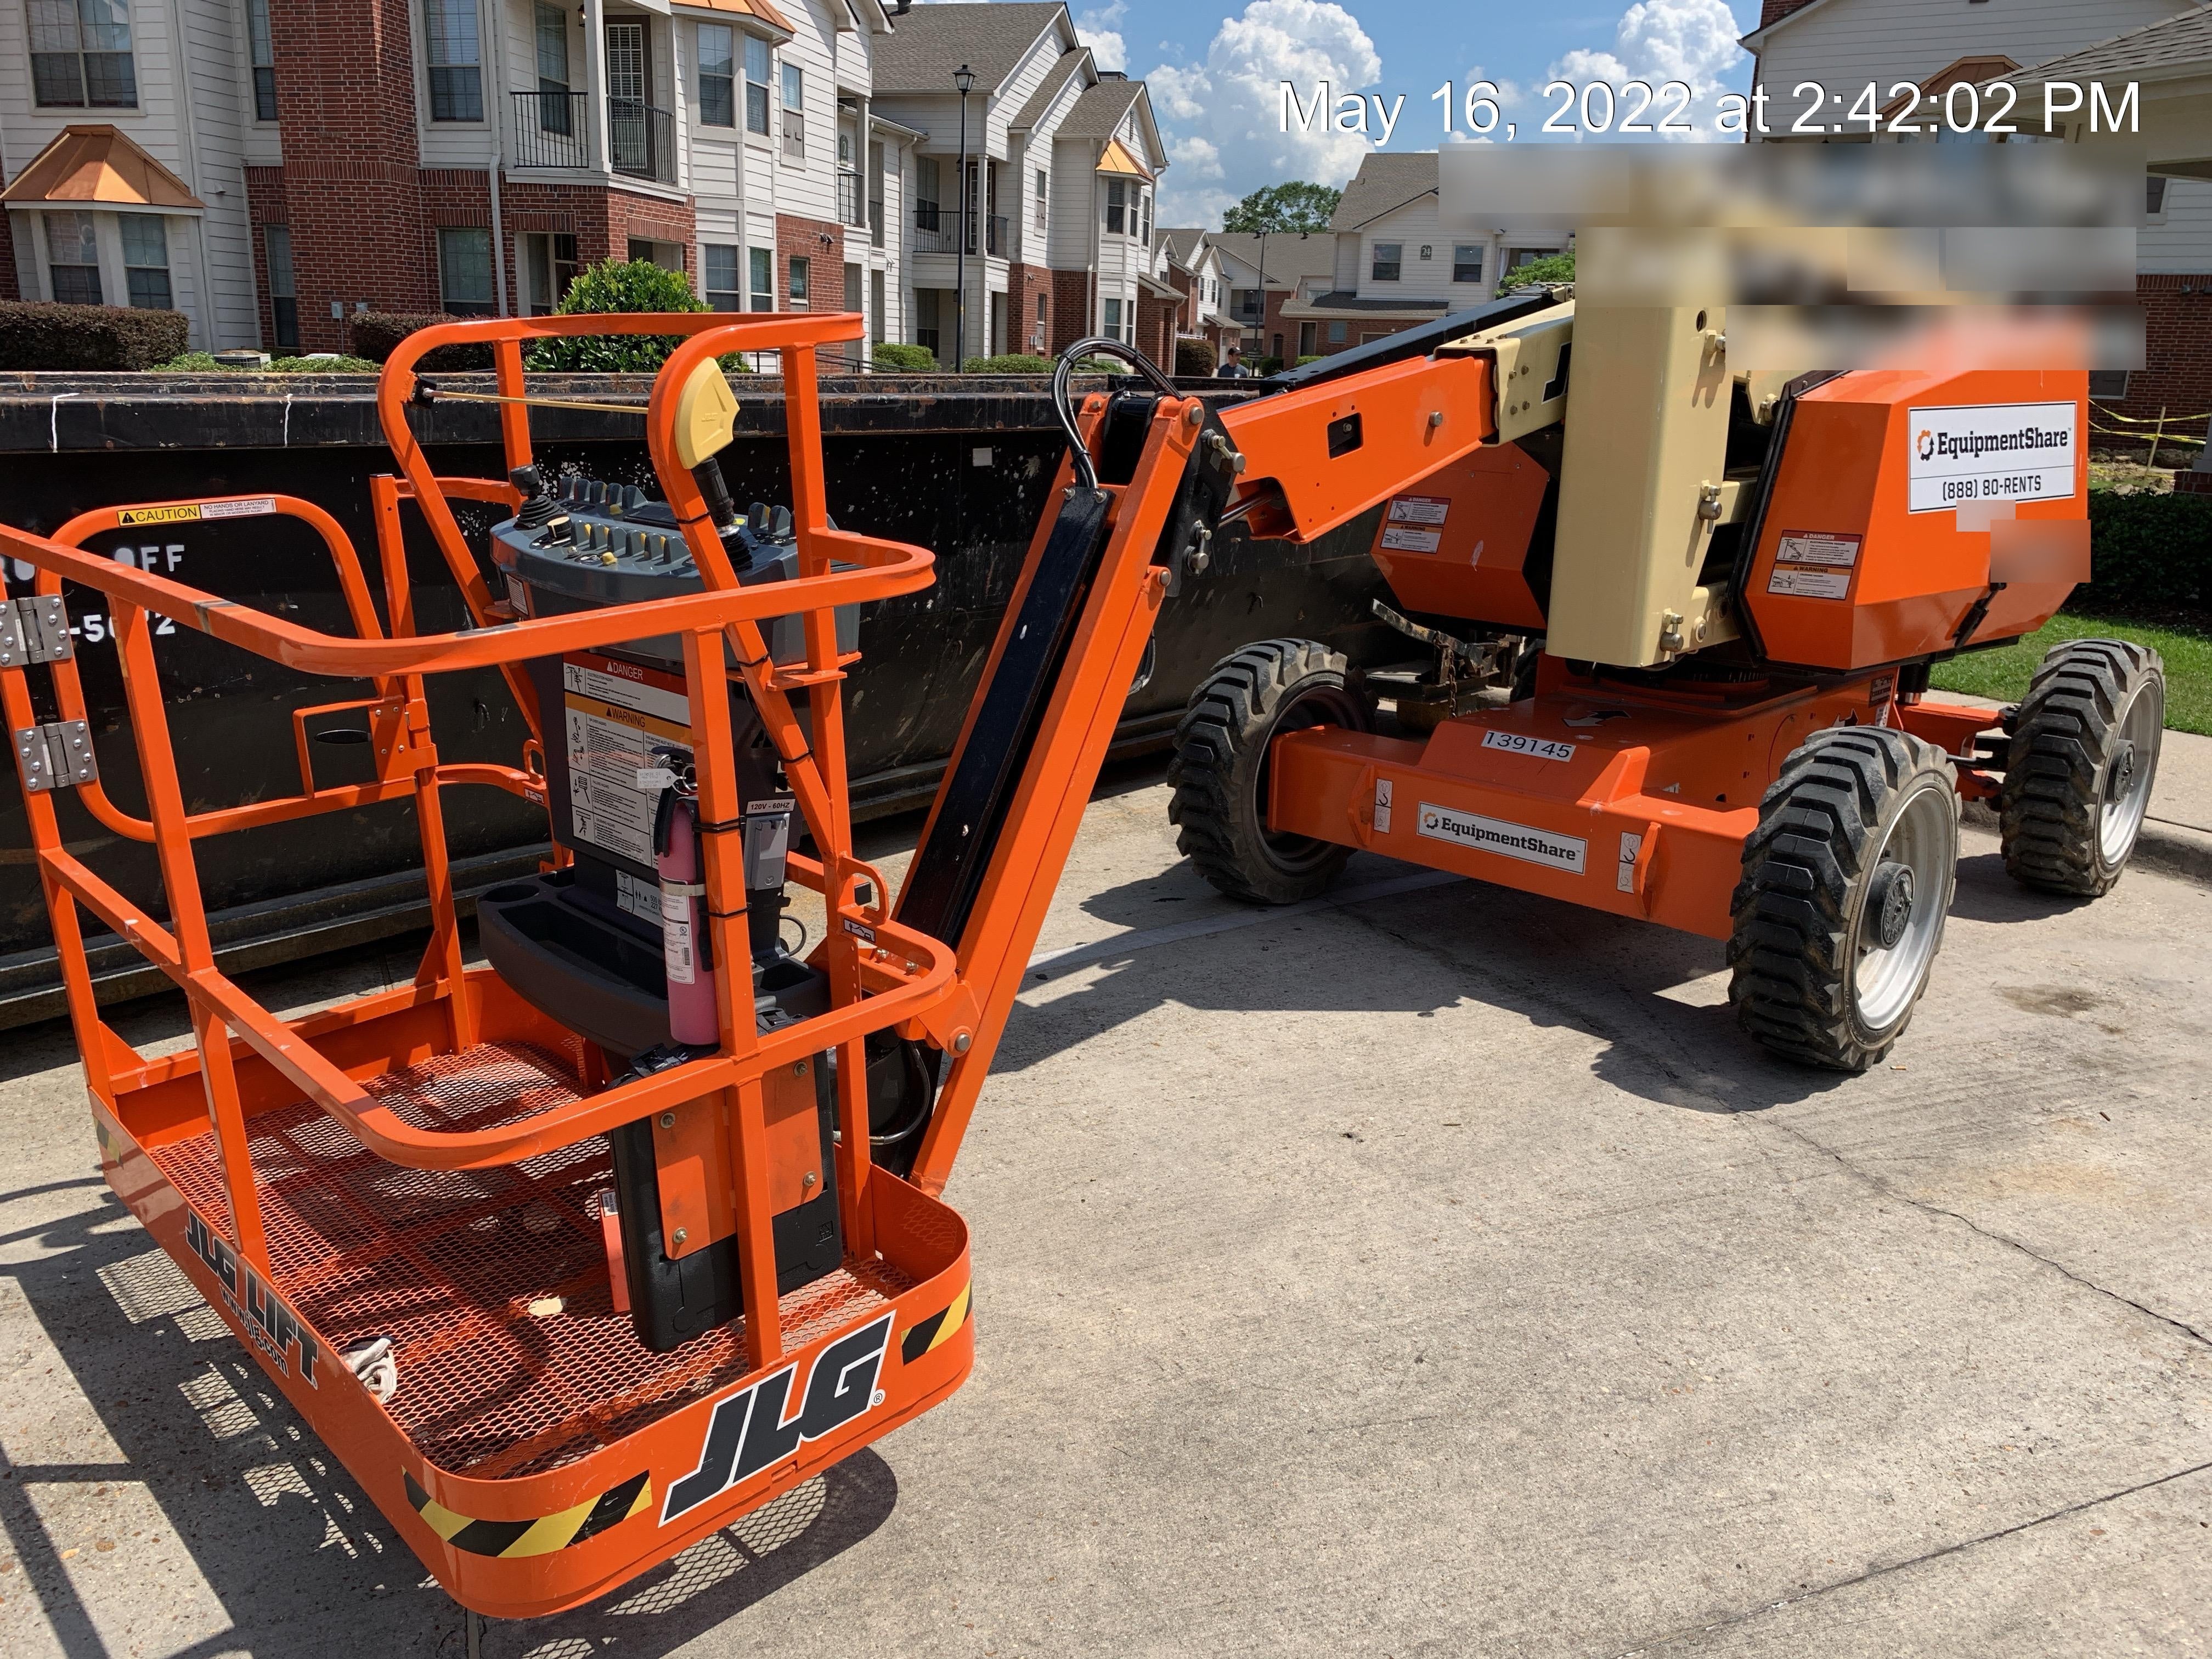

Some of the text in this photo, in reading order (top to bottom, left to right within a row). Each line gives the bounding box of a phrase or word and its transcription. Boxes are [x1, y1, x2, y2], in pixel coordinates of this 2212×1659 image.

[1421, 247, 1431, 256] 24
[1937, 427, 2068, 460] EquipmentShare
[1943, 475, 2041, 501] (888) 80-RENTS
[136, 507, 198, 522] CAUTION
[613, 662, 644, 681] DANGER
[612, 707, 646, 727] WARNING
[1485, 731, 1573, 758] 139145
[1441, 817, 1577, 861] EquipmentShare
[185, 1207, 319, 1388] JLG LIFT
[218, 1282, 290, 1379] www.jlg.com
[657, 1309, 898, 1529] JLG
